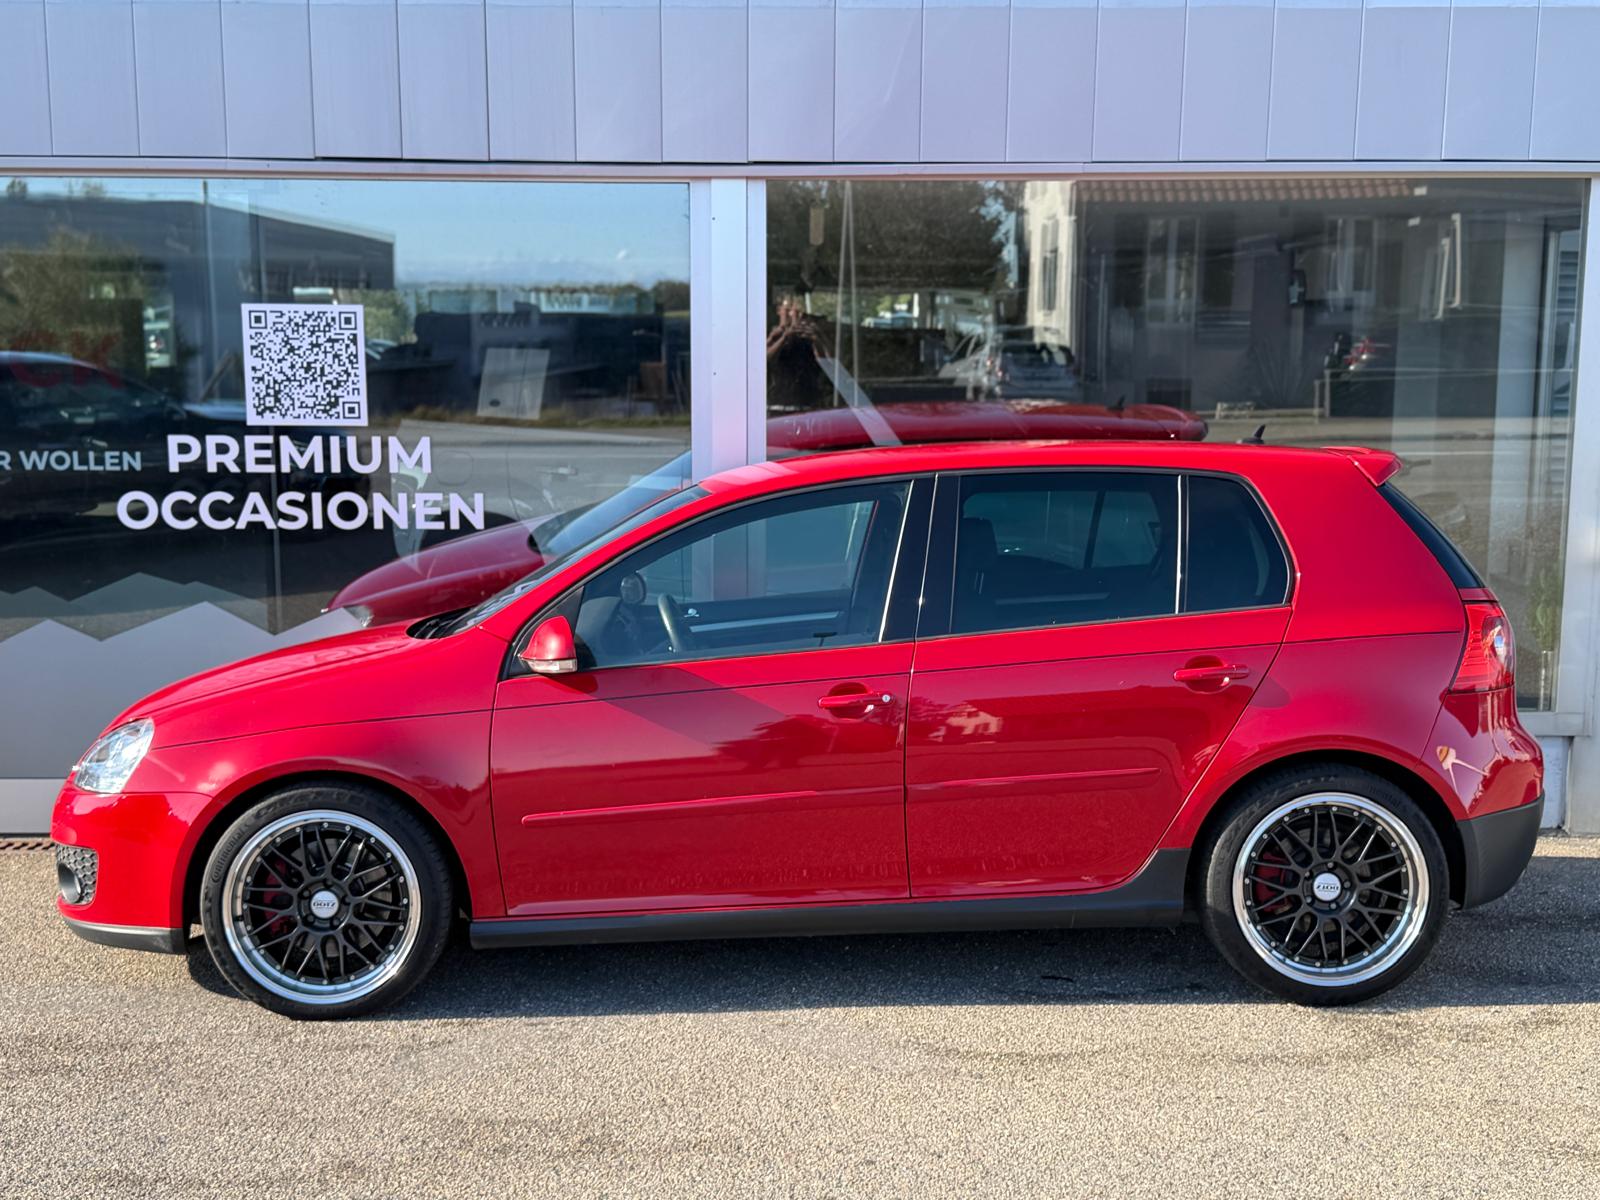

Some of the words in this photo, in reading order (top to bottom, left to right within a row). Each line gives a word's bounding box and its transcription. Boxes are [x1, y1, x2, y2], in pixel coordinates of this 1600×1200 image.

[18, 450, 142, 471] WOLLEN
[166, 434, 432, 474] PREMIUM
[116, 490, 485, 531] OCCASIONEN
